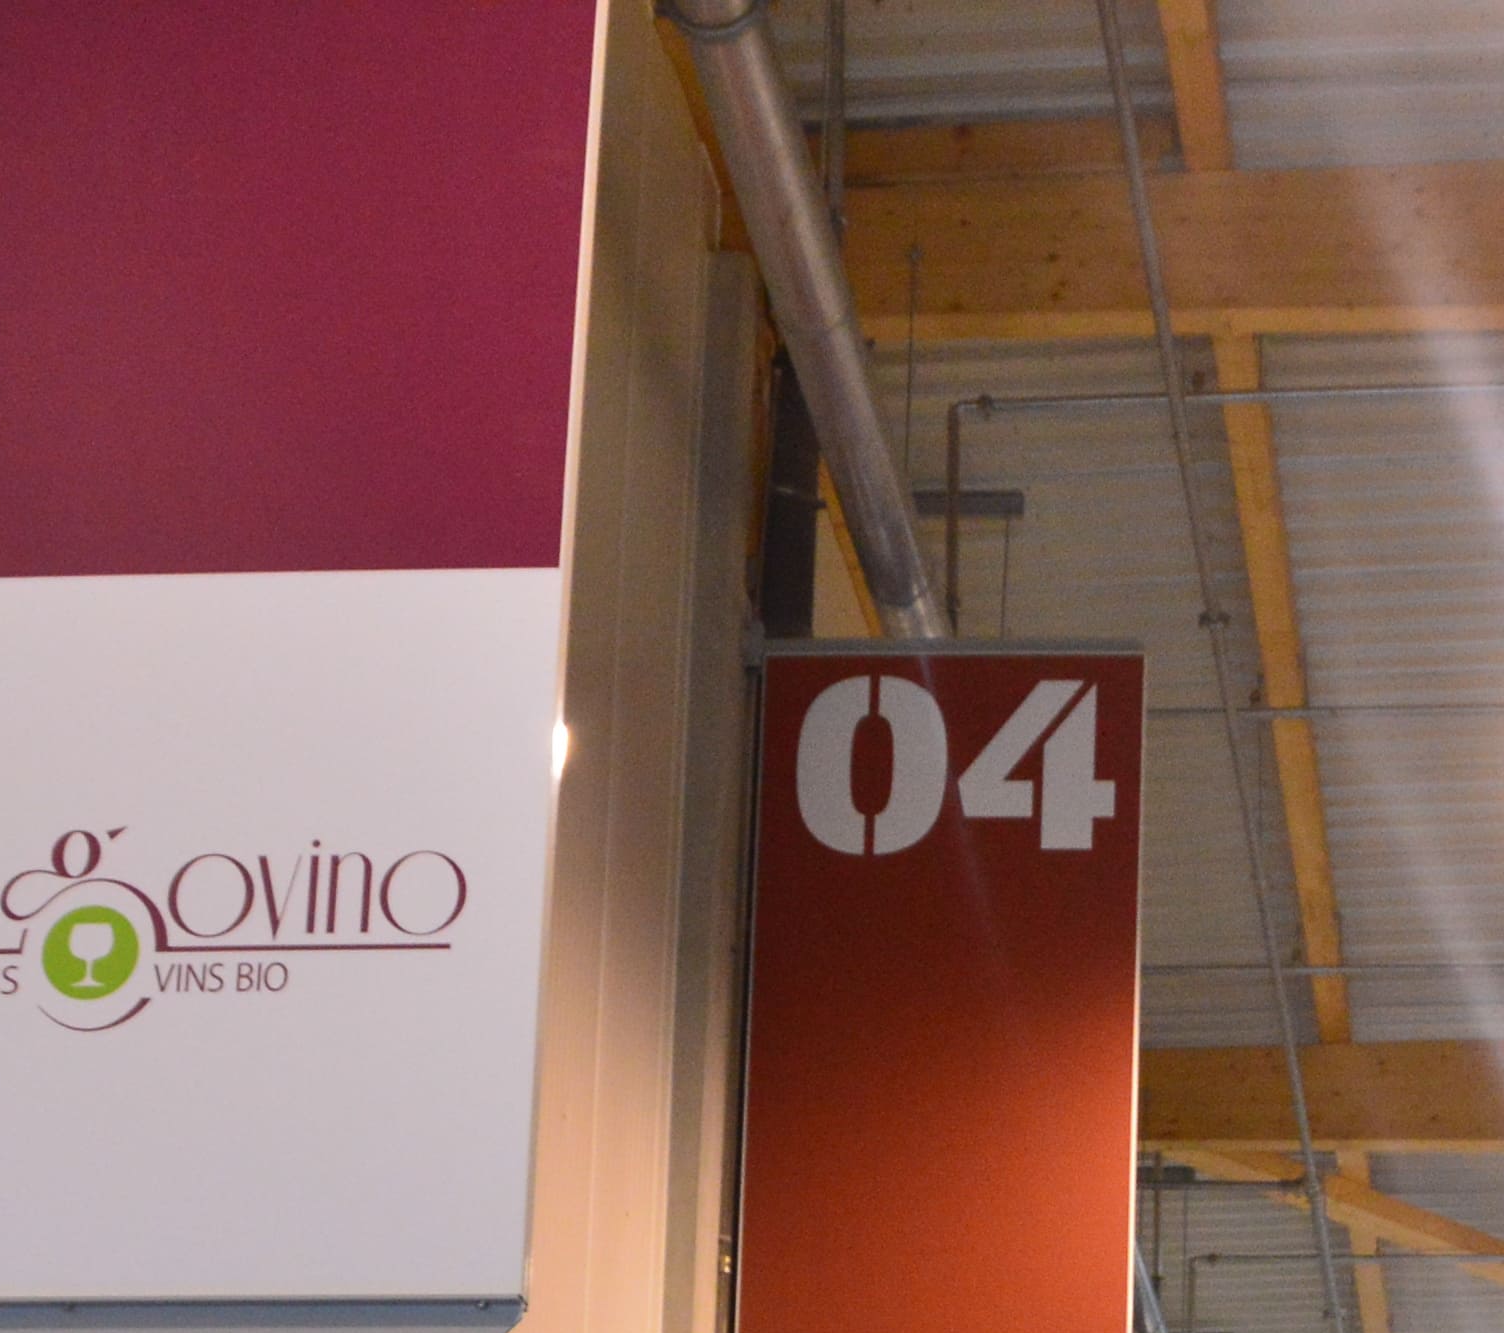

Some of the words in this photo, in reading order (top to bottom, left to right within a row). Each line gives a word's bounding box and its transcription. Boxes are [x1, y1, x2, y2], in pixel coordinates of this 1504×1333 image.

[796, 675, 1116, 856] 04
[153, 963, 225, 993] VINS
[235, 962, 289, 993] BIO
